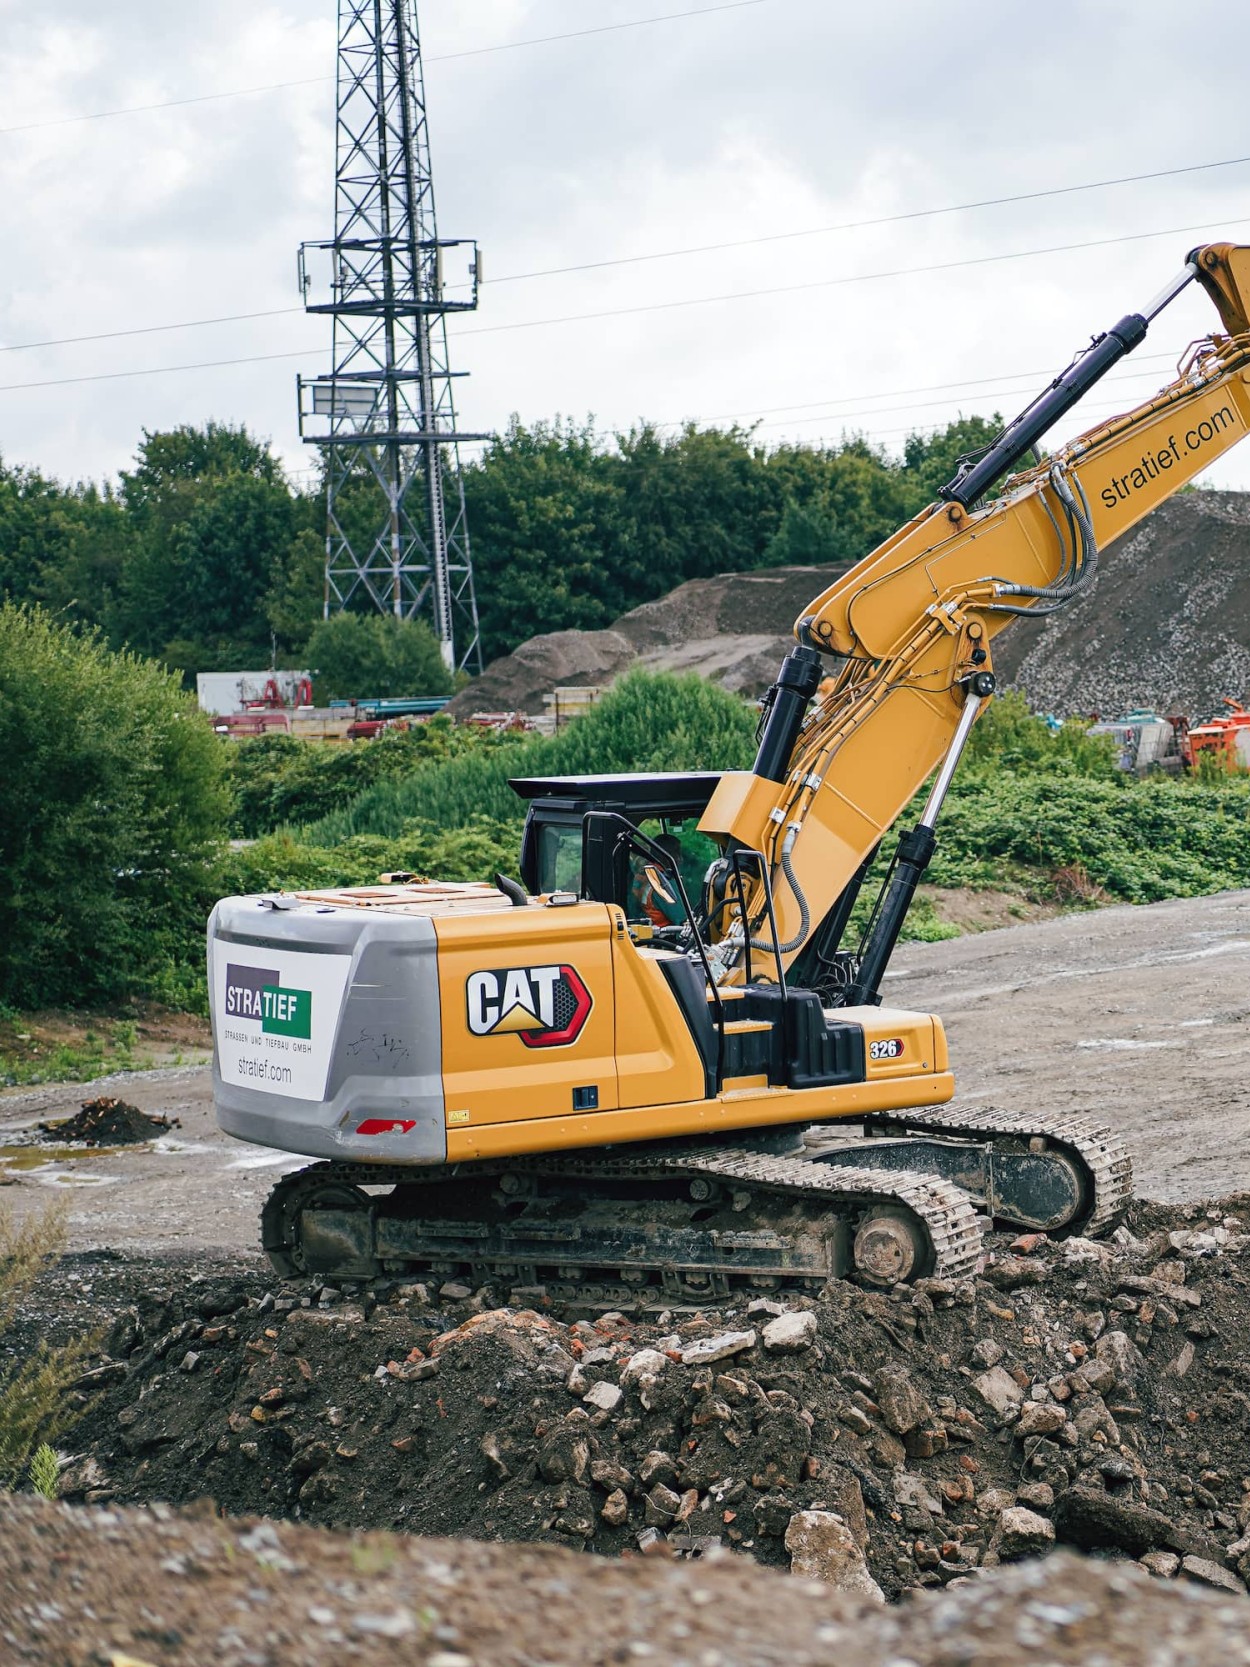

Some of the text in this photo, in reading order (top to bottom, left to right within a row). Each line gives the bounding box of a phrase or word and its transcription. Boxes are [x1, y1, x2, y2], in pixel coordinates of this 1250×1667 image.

[1101, 406, 1235, 508] stratief.com
[227, 985, 298, 1021] STRATIEF
[467, 966, 561, 1034] CAT
[225, 1030, 312, 1053] STRASSEN UND TIEFBAU GMBH
[870, 1040, 898, 1059] 326
[238, 1056, 292, 1084] stratief.com
